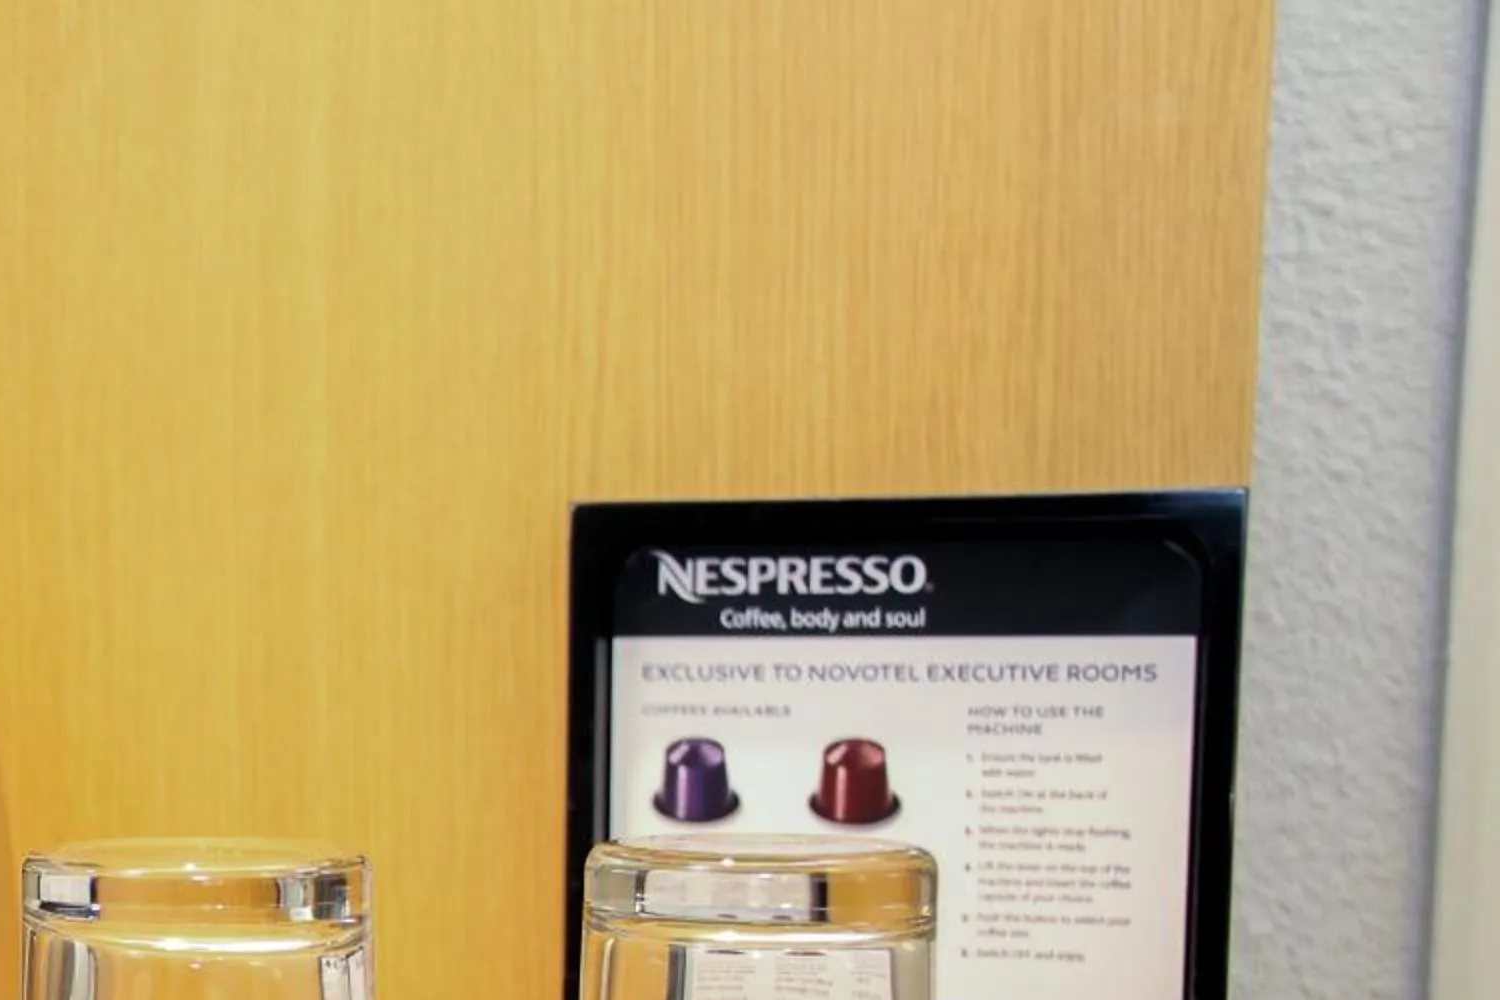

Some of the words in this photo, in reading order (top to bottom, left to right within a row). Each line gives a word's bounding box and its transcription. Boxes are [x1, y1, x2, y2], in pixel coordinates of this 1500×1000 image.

[651, 549, 927, 604] NESPRESSO
[719, 607, 786, 631] Coffee,
[790, 605, 840, 634] body
[842, 606, 881, 629] and
[886, 607, 926, 629] soul
[641, 663, 766, 683] EXCLUSIVE
[772, 663, 802, 683] TO
[807, 663, 920, 683] NOVOTEL
[926, 663, 1060, 683] EXECUTIVE
[1066, 662, 1158, 683] ROOMS
[967, 705, 1007, 719] HOW
[1012, 705, 1033, 719] TO
[1036, 705, 1068, 719] USE
[1072, 705, 1105, 719] THE
[966, 722, 1043, 736] MACHINE
